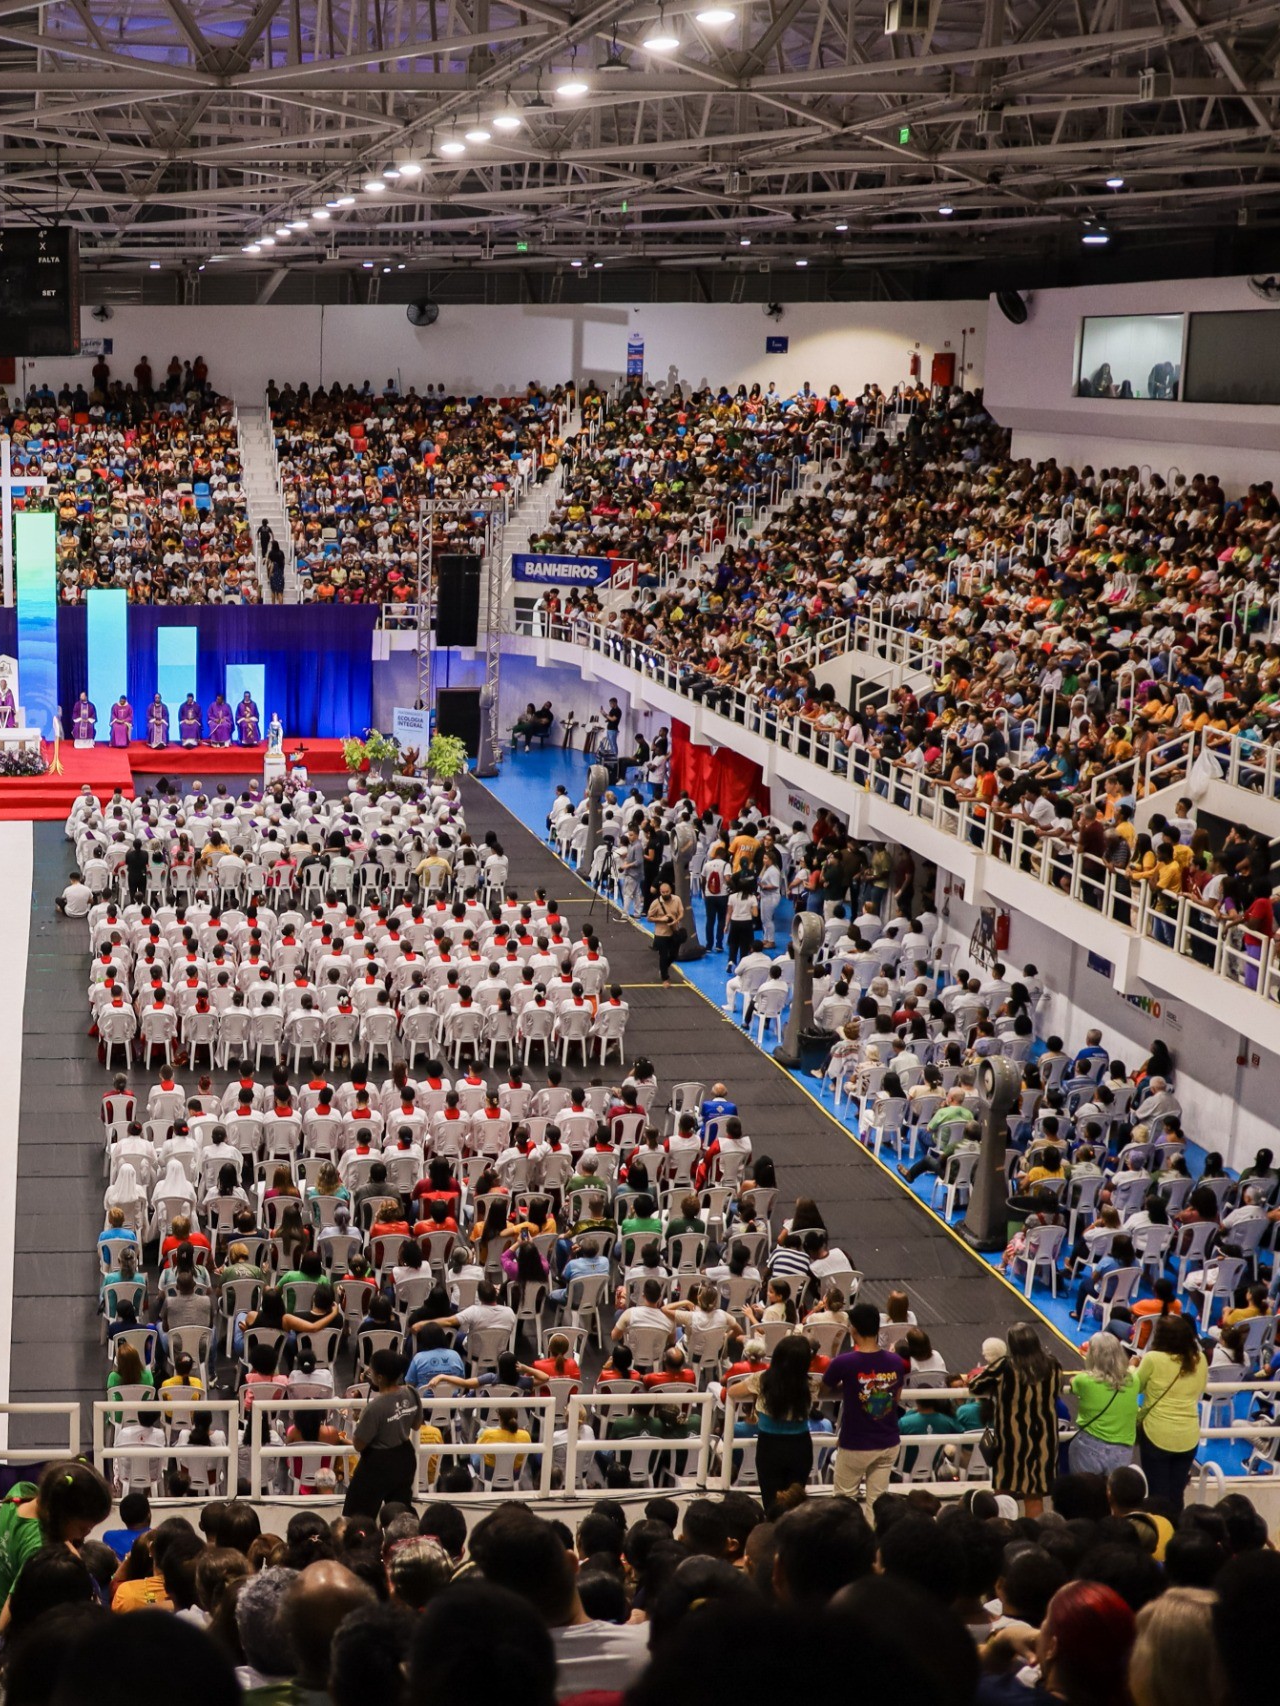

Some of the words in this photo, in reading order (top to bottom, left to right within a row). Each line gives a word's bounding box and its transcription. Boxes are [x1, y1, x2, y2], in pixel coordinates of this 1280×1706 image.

[525, 562, 598, 579] BANHEIROS
[397, 716, 424, 724] ECOLOGIA
[397, 721, 424, 729] INTEGRAL
